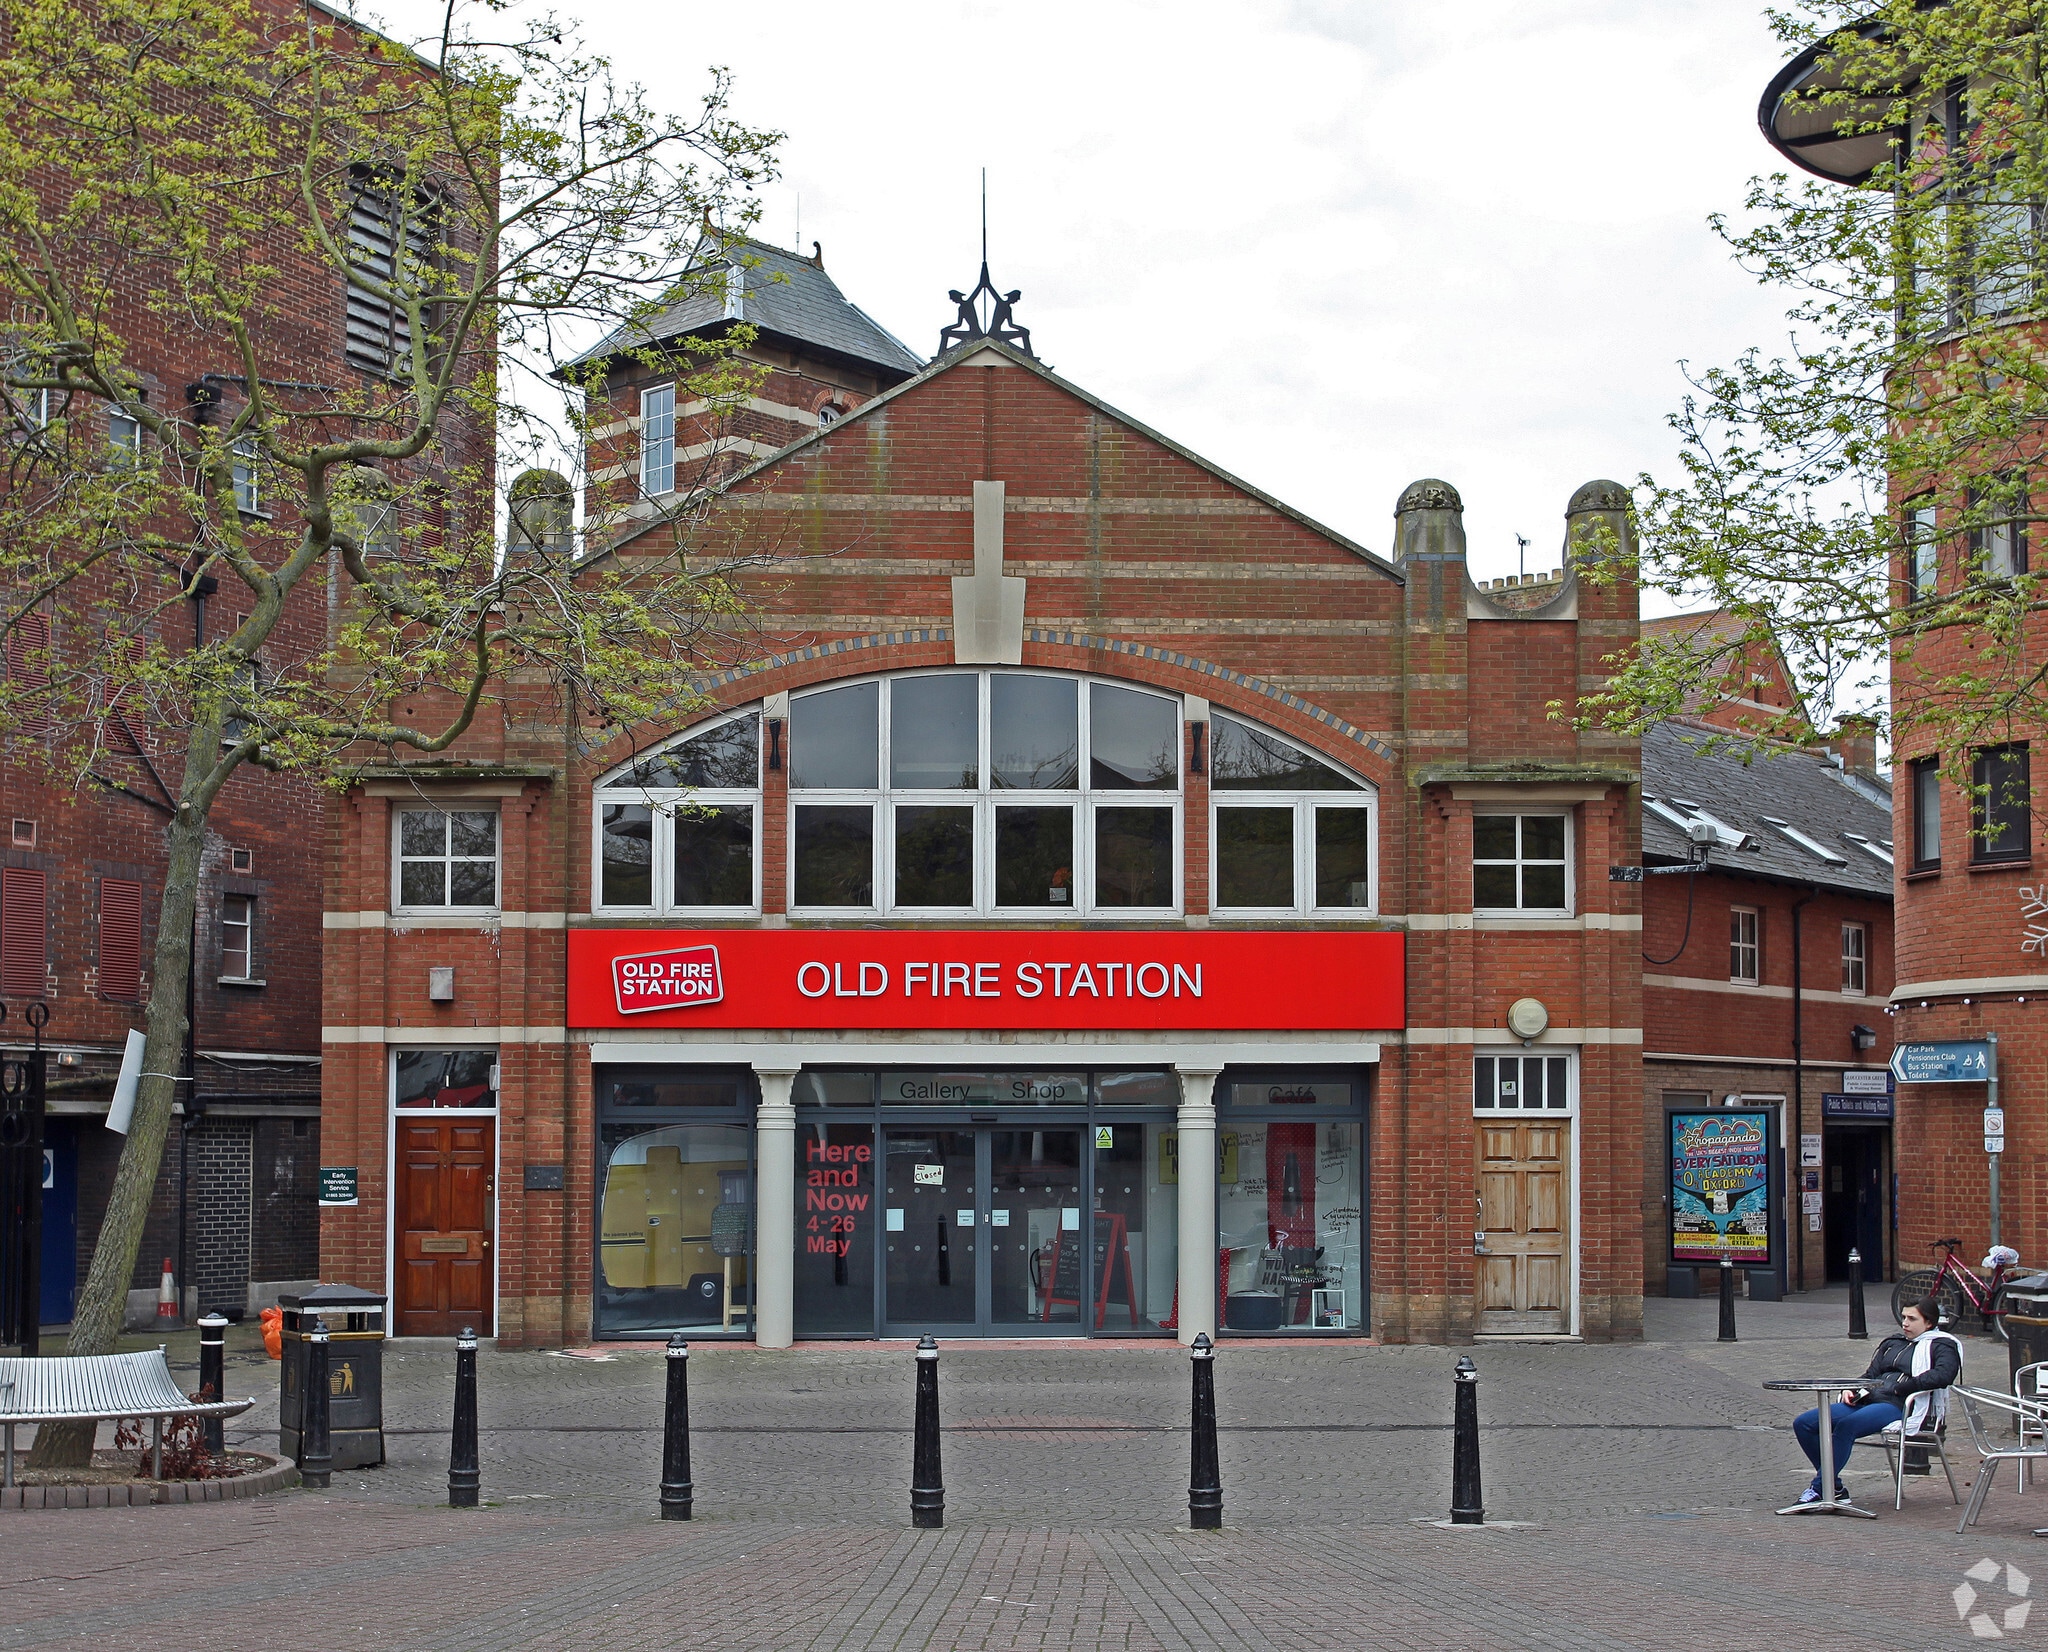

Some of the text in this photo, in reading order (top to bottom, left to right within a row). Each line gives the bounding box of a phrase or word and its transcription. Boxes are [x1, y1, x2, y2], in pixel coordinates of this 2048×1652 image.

[623, 963, 713, 978] OLD FIRE
[622, 979, 713, 995] STATION
[797, 961, 1202, 998] OLD FIRE STATION
[900, 1082, 1065, 1100] Gallery Shop
[1269, 1086, 1314, 1103] Café
[1829, 1099, 1841, 1109] Public
[1687, 1131, 1758, 1146] Propaganda
[807, 1139, 871, 1162] Here
[1674, 1154, 1766, 1169] EVERY SATURDAY
[807, 1164, 858, 1187] and
[915, 1167, 942, 1181] Closed
[1698, 1167, 1753, 1178] ACADEMY
[1703, 1179, 1745, 1190] OXFORD
[807, 1189, 869, 1211] Now
[807, 1236, 851, 1257] May
